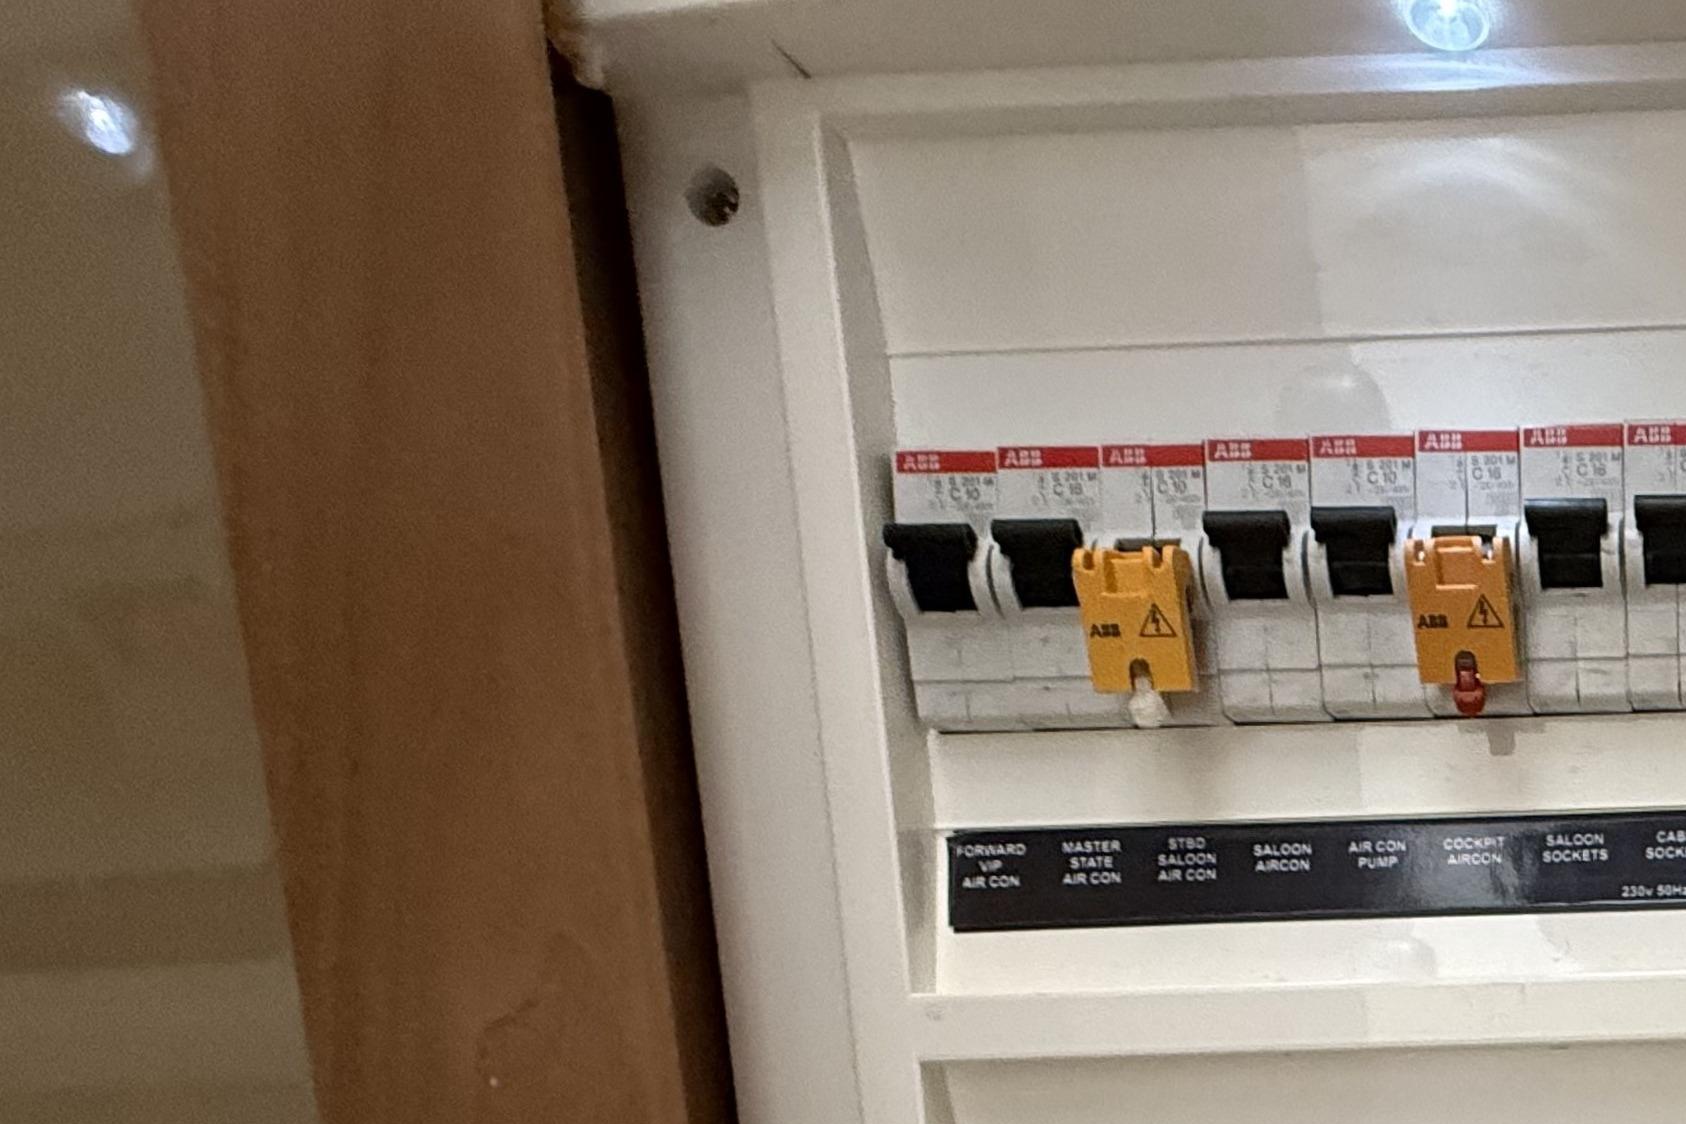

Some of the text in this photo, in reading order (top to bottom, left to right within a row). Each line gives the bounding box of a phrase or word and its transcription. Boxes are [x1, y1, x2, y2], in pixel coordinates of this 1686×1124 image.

[1424, 433, 1463, 449] ABB
[1530, 429, 1567, 444] ABB
[1633, 427, 1671, 443] ABB
[1214, 443, 1252, 458] ABB
[1319, 439, 1357, 455] ABB
[1004, 450, 1042, 466] ABB
[1109, 448, 1147, 464] ABB
[1418, 614, 1448, 629] ABB
[1090, 623, 1121, 638] ABB
[1061, 840, 1121, 853] MASTER
[1348, 840, 1407, 853] AIR CON
[1443, 836, 1505, 850] COCKPIT
[1546, 833, 1604, 846] SALOON
[956, 843, 1027, 858] FORWARD
[1253, 843, 1312, 856] SALOON
[1542, 849, 1609, 863] SOCKETS
[978, 860, 1002, 872] VIP
[1069, 856, 1113, 869] STATE
[1158, 853, 1217, 866] SALOON
[1358, 856, 1399, 868] PUMP
[962, 875, 1021, 889] AIR CON
[1062, 871, 1122, 885] AIR CON
[1158, 868, 1217, 882] AIR CON
[1621, 886, 1653, 897] 230v
